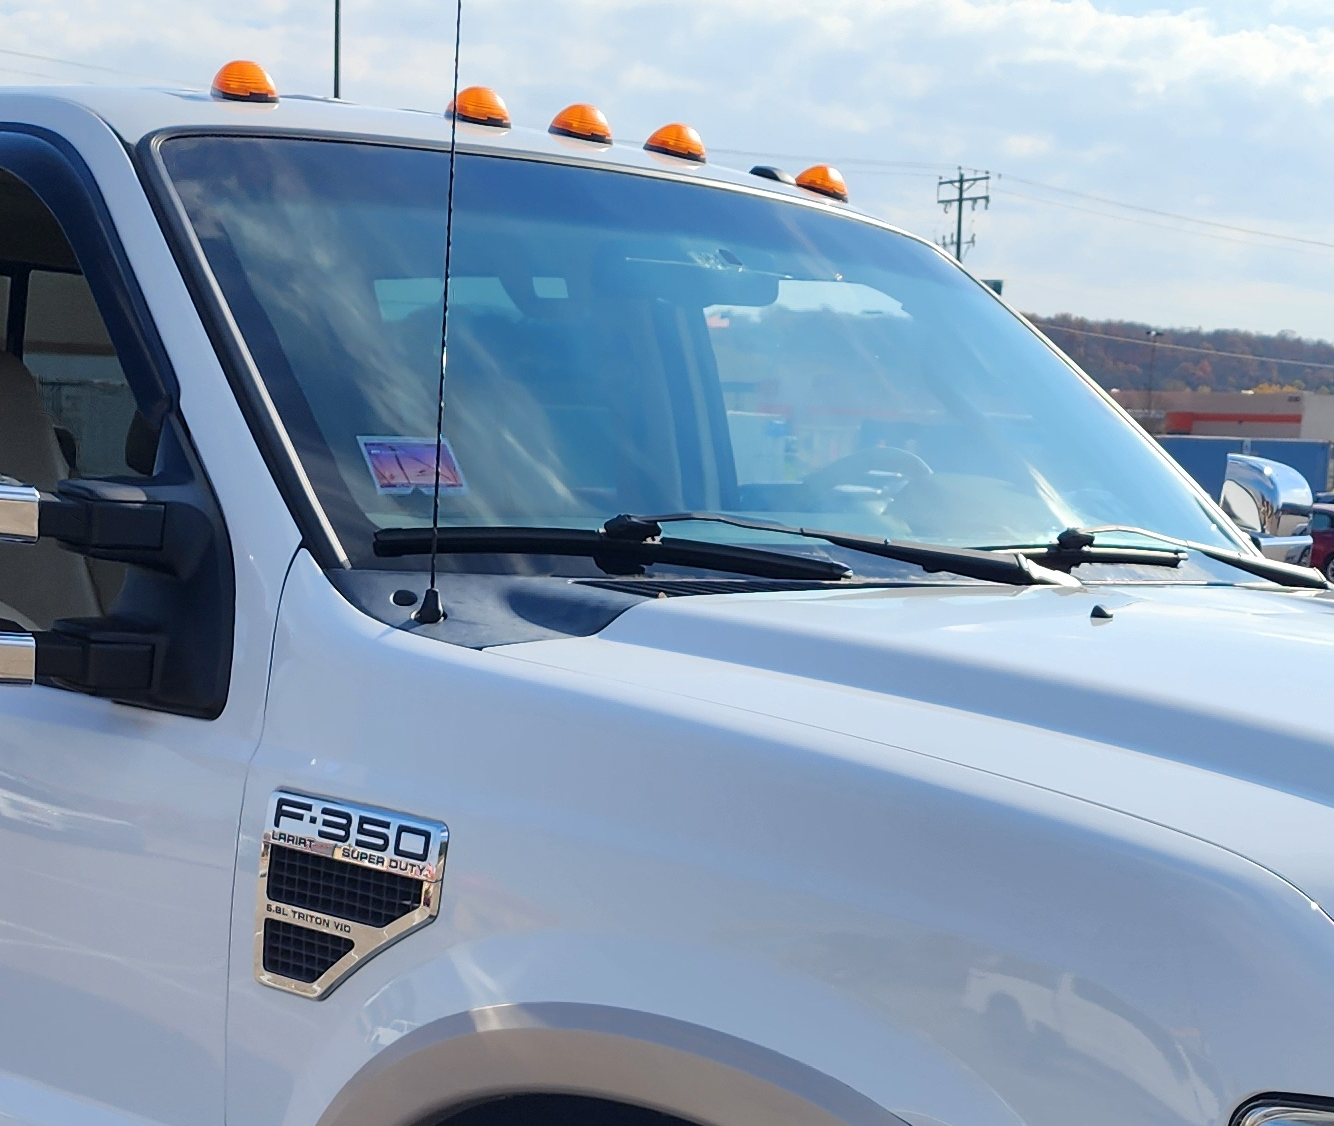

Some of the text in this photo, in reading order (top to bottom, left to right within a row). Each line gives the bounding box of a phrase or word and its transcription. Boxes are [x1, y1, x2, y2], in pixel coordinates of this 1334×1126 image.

[271, 830, 315, 849] LARIAT
[341, 847, 425, 876] SUPER DUTY
[266, 903, 288, 916] 6.8L
[291, 910, 330, 929] TRITON
